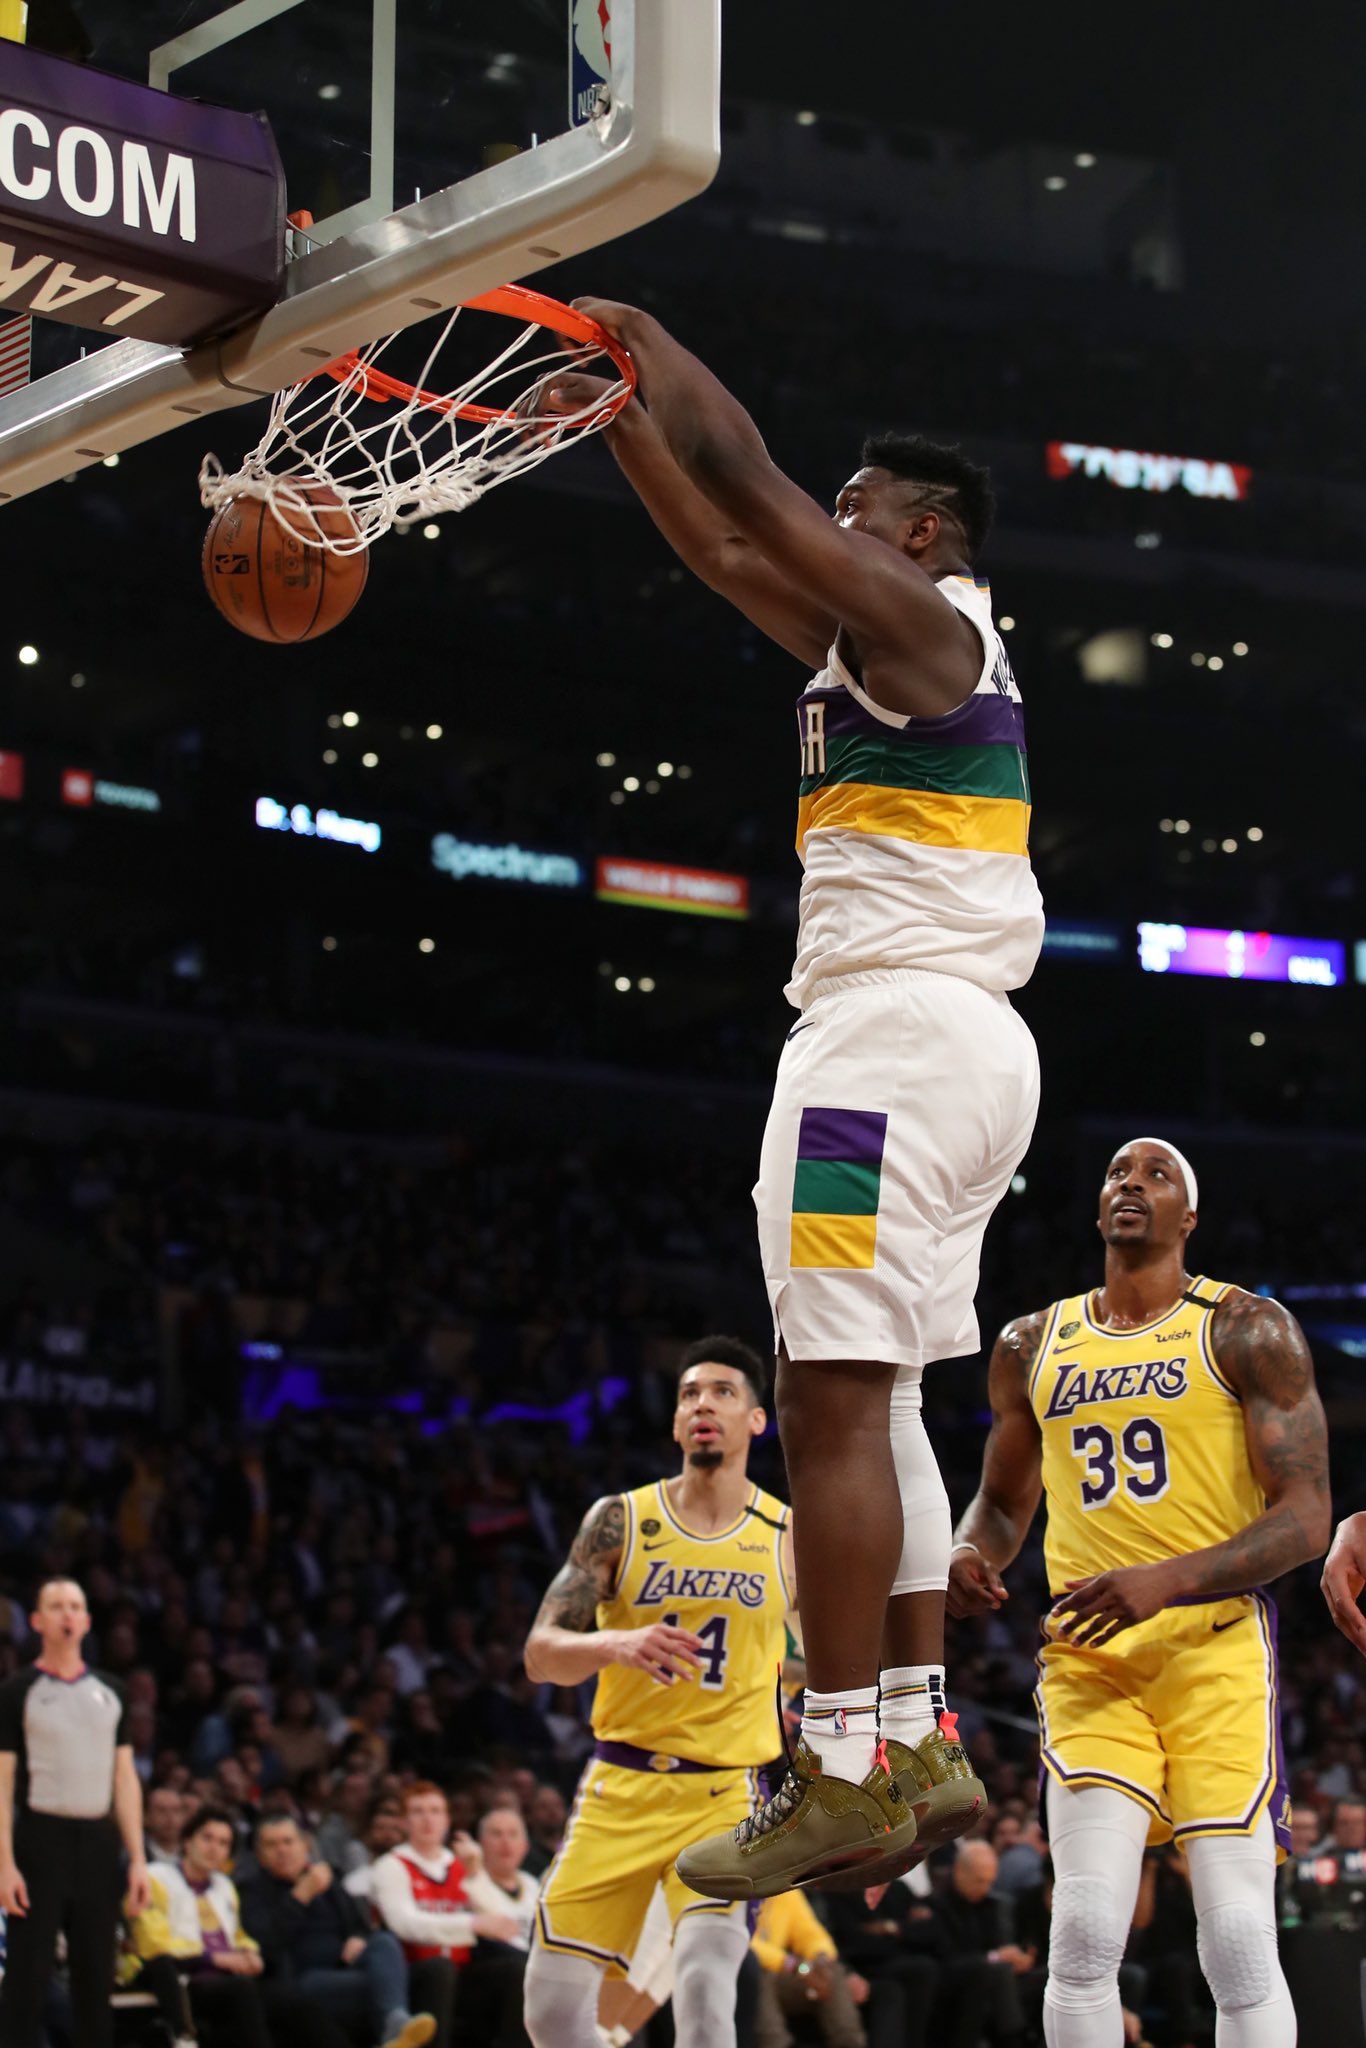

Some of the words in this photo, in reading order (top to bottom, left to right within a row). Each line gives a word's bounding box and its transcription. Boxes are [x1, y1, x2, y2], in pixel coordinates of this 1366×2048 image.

[0, 109, 196, 243] COM
[431, 832, 579, 887] Spectrum
[1155, 1329, 1192, 1343] wish
[1043, 1357, 1188, 1420] LAKERS
[1071, 1417, 1170, 1512] 39
[632, 1559, 766, 1609] LAKERS
